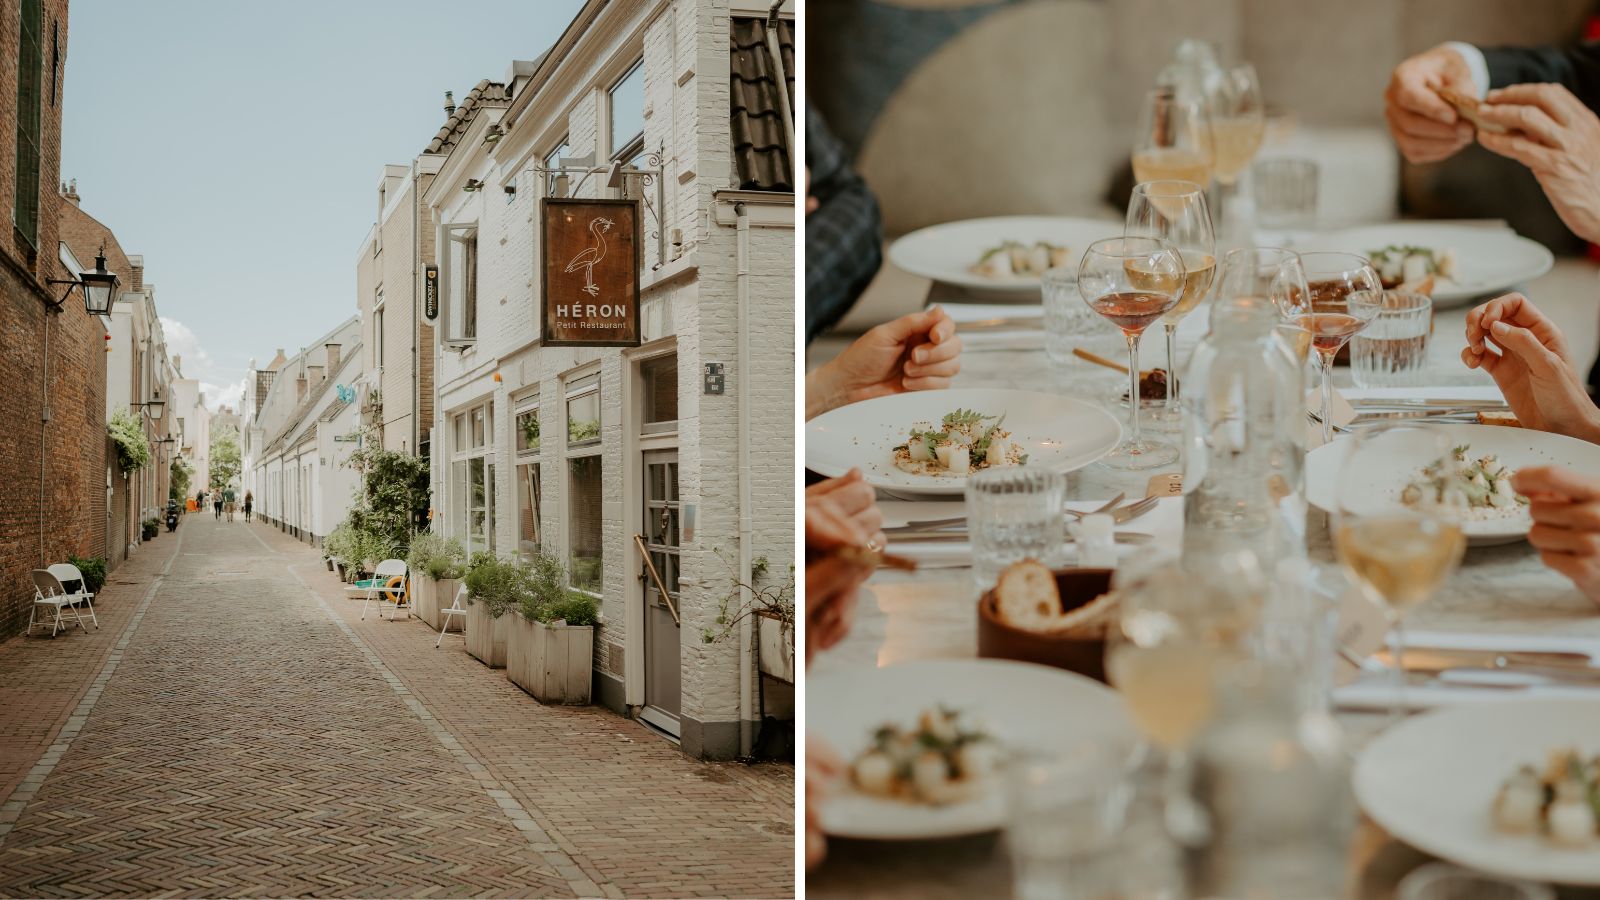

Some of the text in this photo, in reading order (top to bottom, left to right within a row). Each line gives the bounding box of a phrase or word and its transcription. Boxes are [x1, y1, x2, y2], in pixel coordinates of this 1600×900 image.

[556, 301, 626, 318] HÉRON
[557, 321, 626, 329] Petit Restaurant
